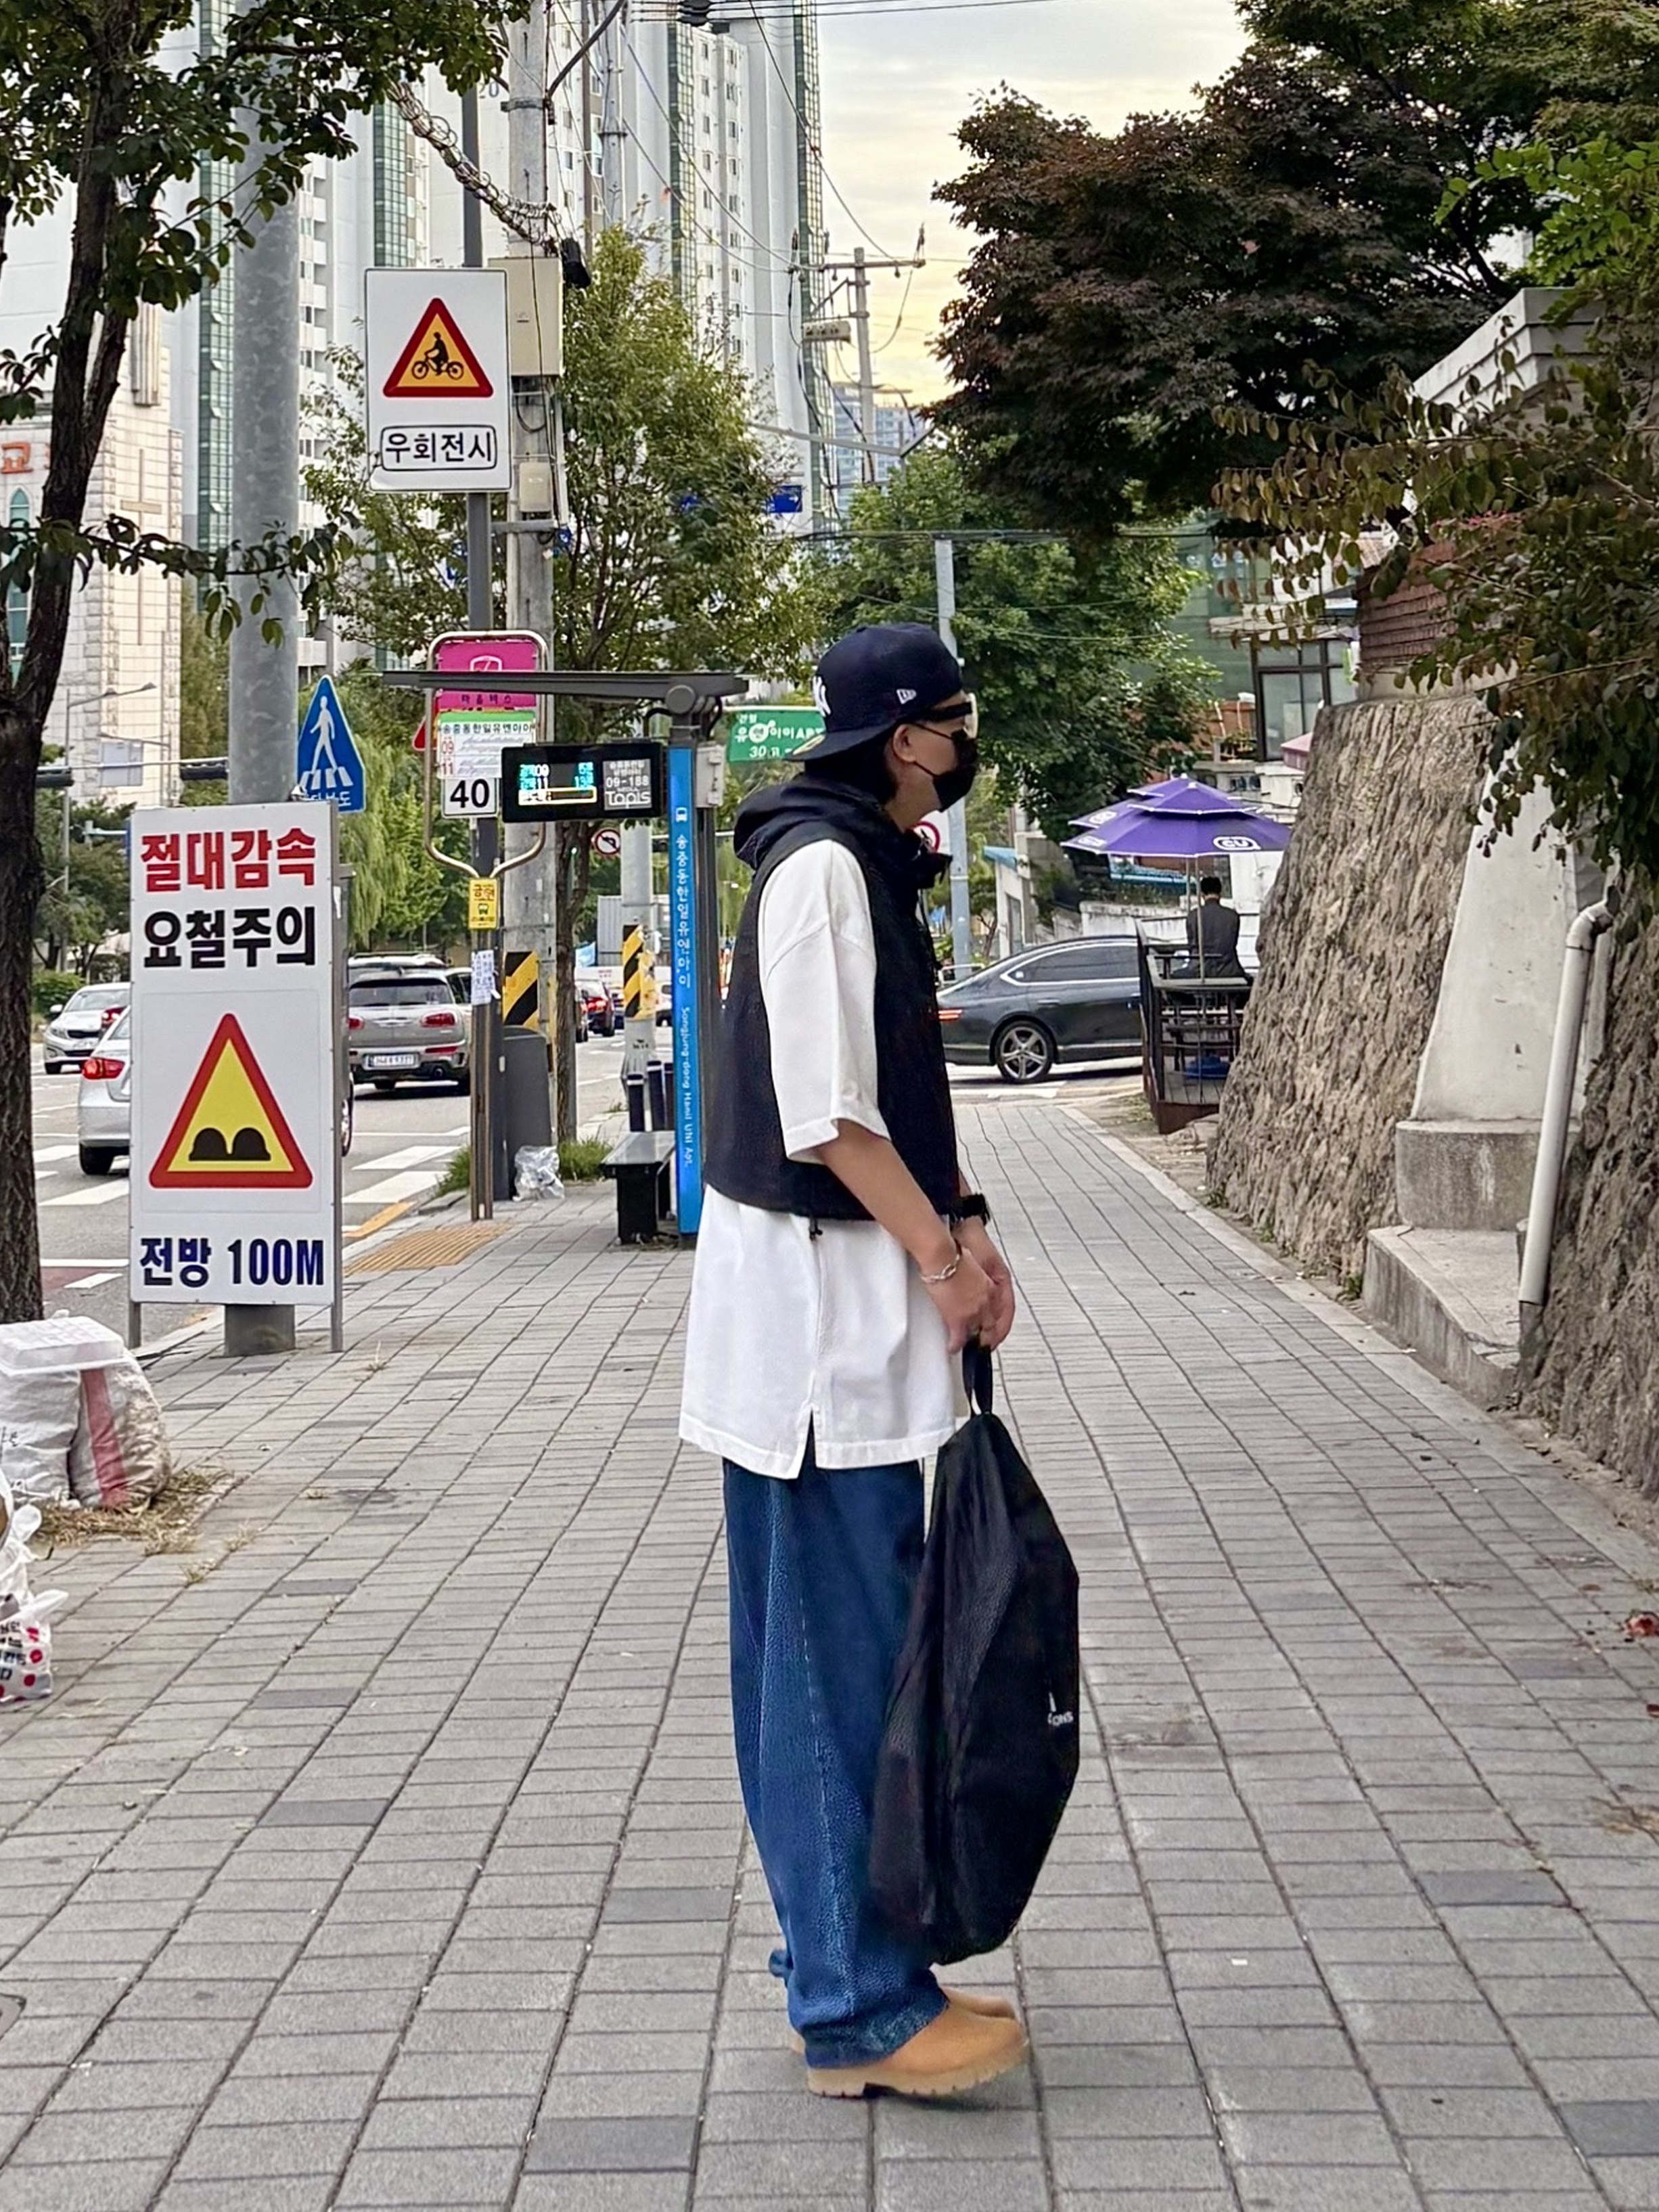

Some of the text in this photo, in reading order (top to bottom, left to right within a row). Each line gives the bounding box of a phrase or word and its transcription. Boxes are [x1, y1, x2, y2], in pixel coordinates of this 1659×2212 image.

[386, 432, 491, 463] 우회전시
[450, 779, 490, 808] 40
[606, 776, 649, 788] 09-188
[141, 828, 315, 892] 절대감속
[144, 906, 315, 968] 요철주의
[140, 1238, 324, 1288] 전방 100M
